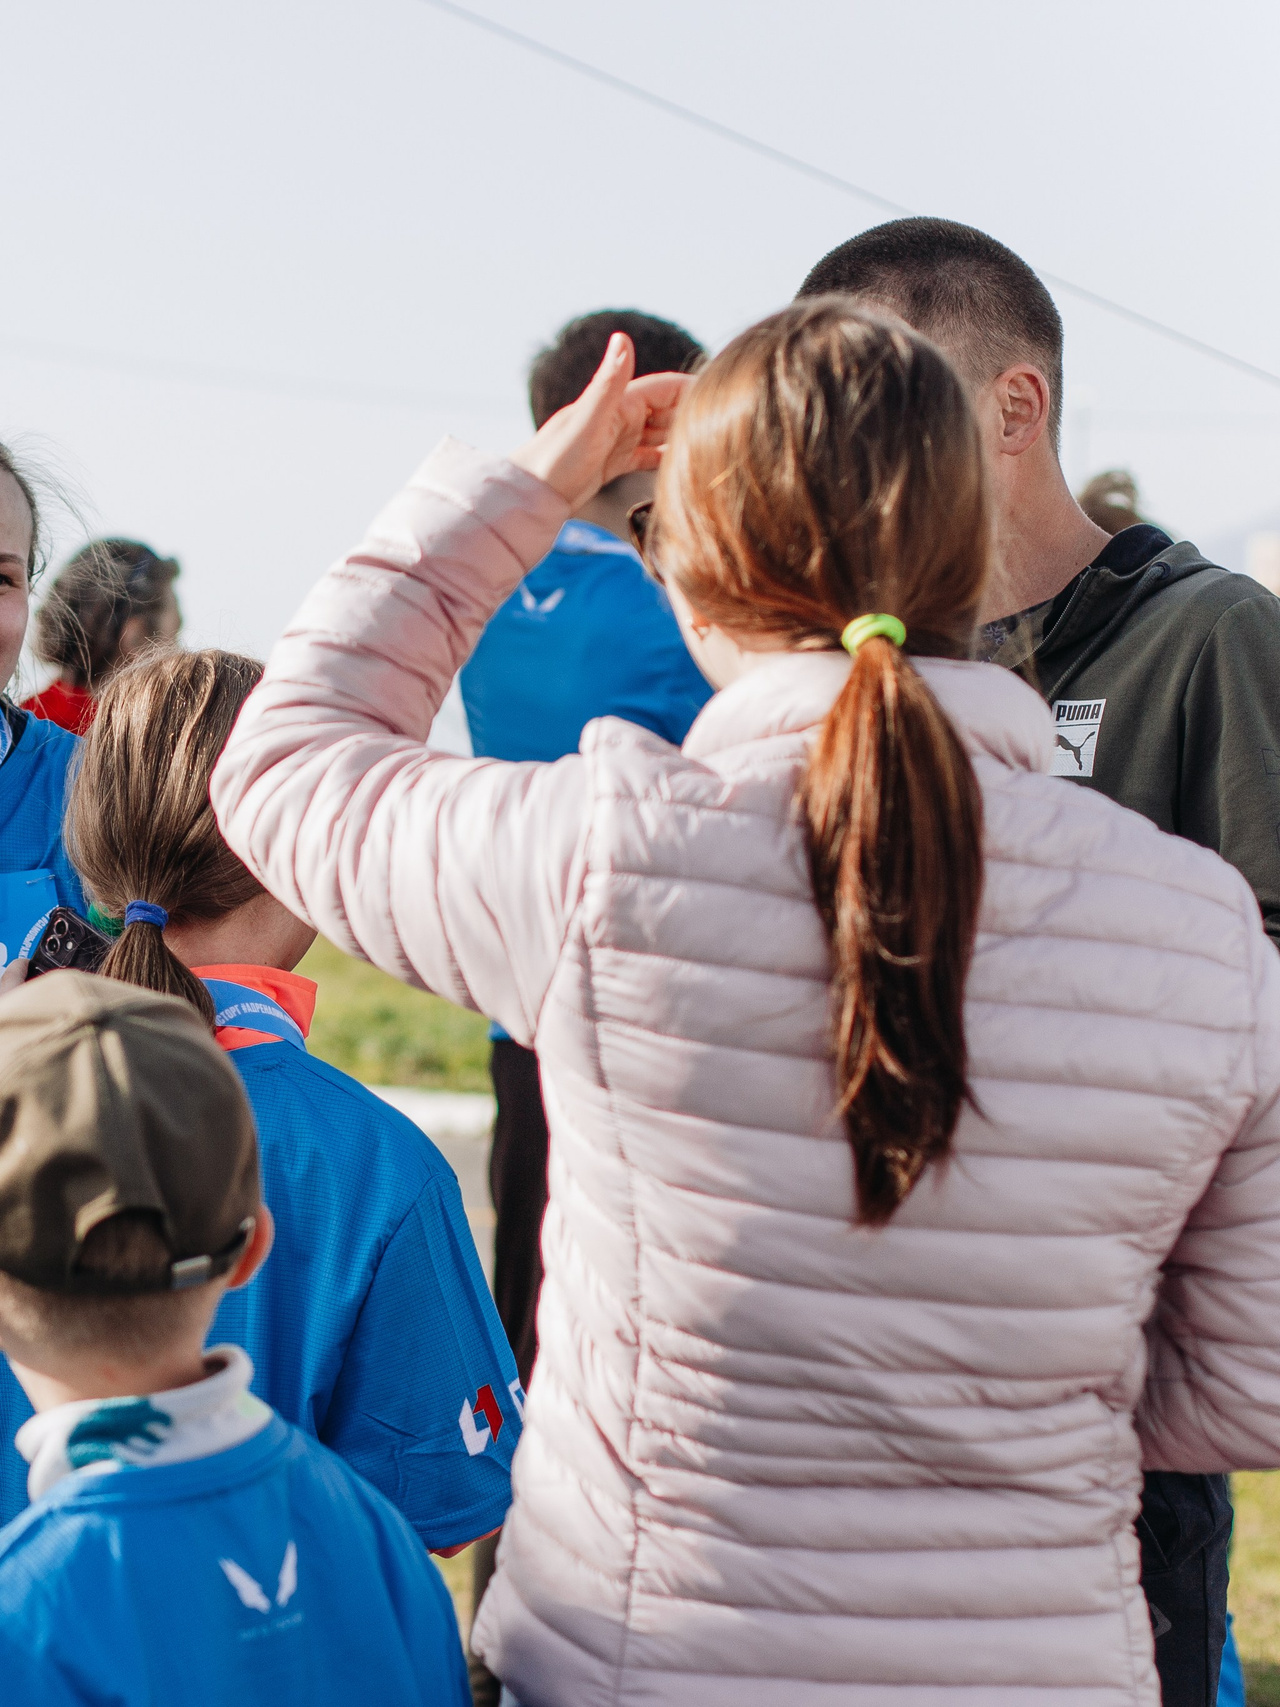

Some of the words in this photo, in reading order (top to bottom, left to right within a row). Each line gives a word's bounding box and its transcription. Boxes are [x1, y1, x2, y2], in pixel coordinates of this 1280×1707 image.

[1056, 703, 1102, 721] PUMA
[18, 915, 50, 960] #САМОВЫРАЖ
[215, 1003, 242, 1026] ОСТОРГ
